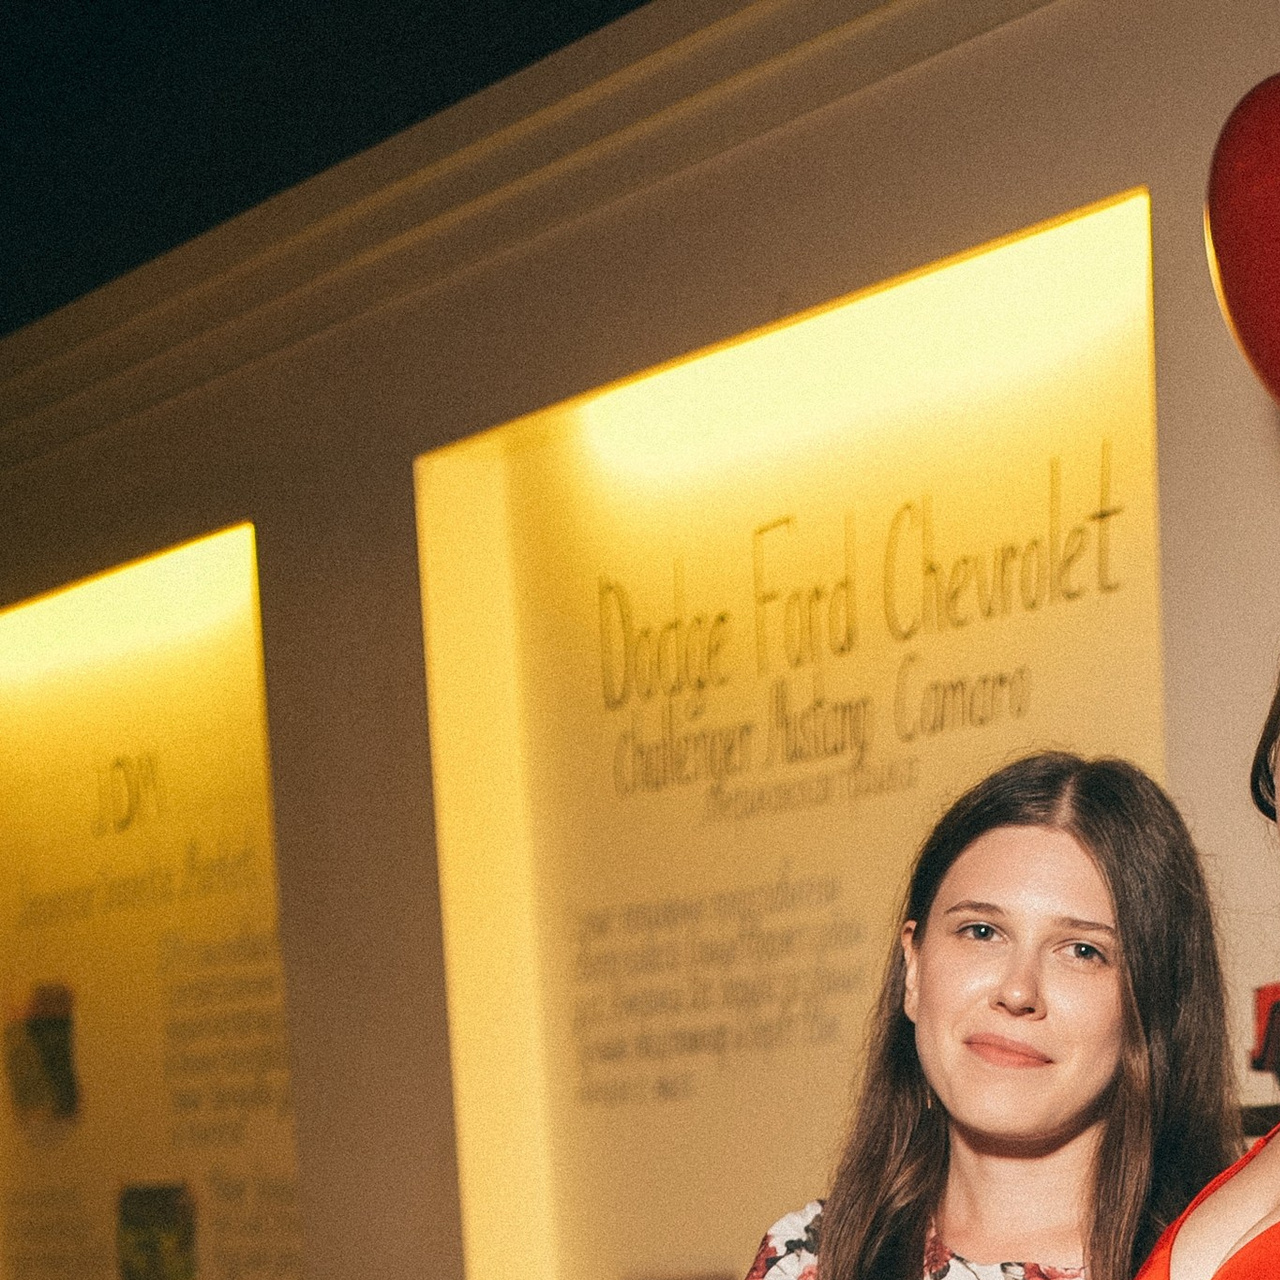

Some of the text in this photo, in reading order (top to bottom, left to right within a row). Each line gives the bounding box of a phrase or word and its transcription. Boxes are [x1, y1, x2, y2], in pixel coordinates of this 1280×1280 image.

[597, 438, 1127, 722] Dodge Ford Chevrolet
[892, 652, 1033, 743] Camaro
